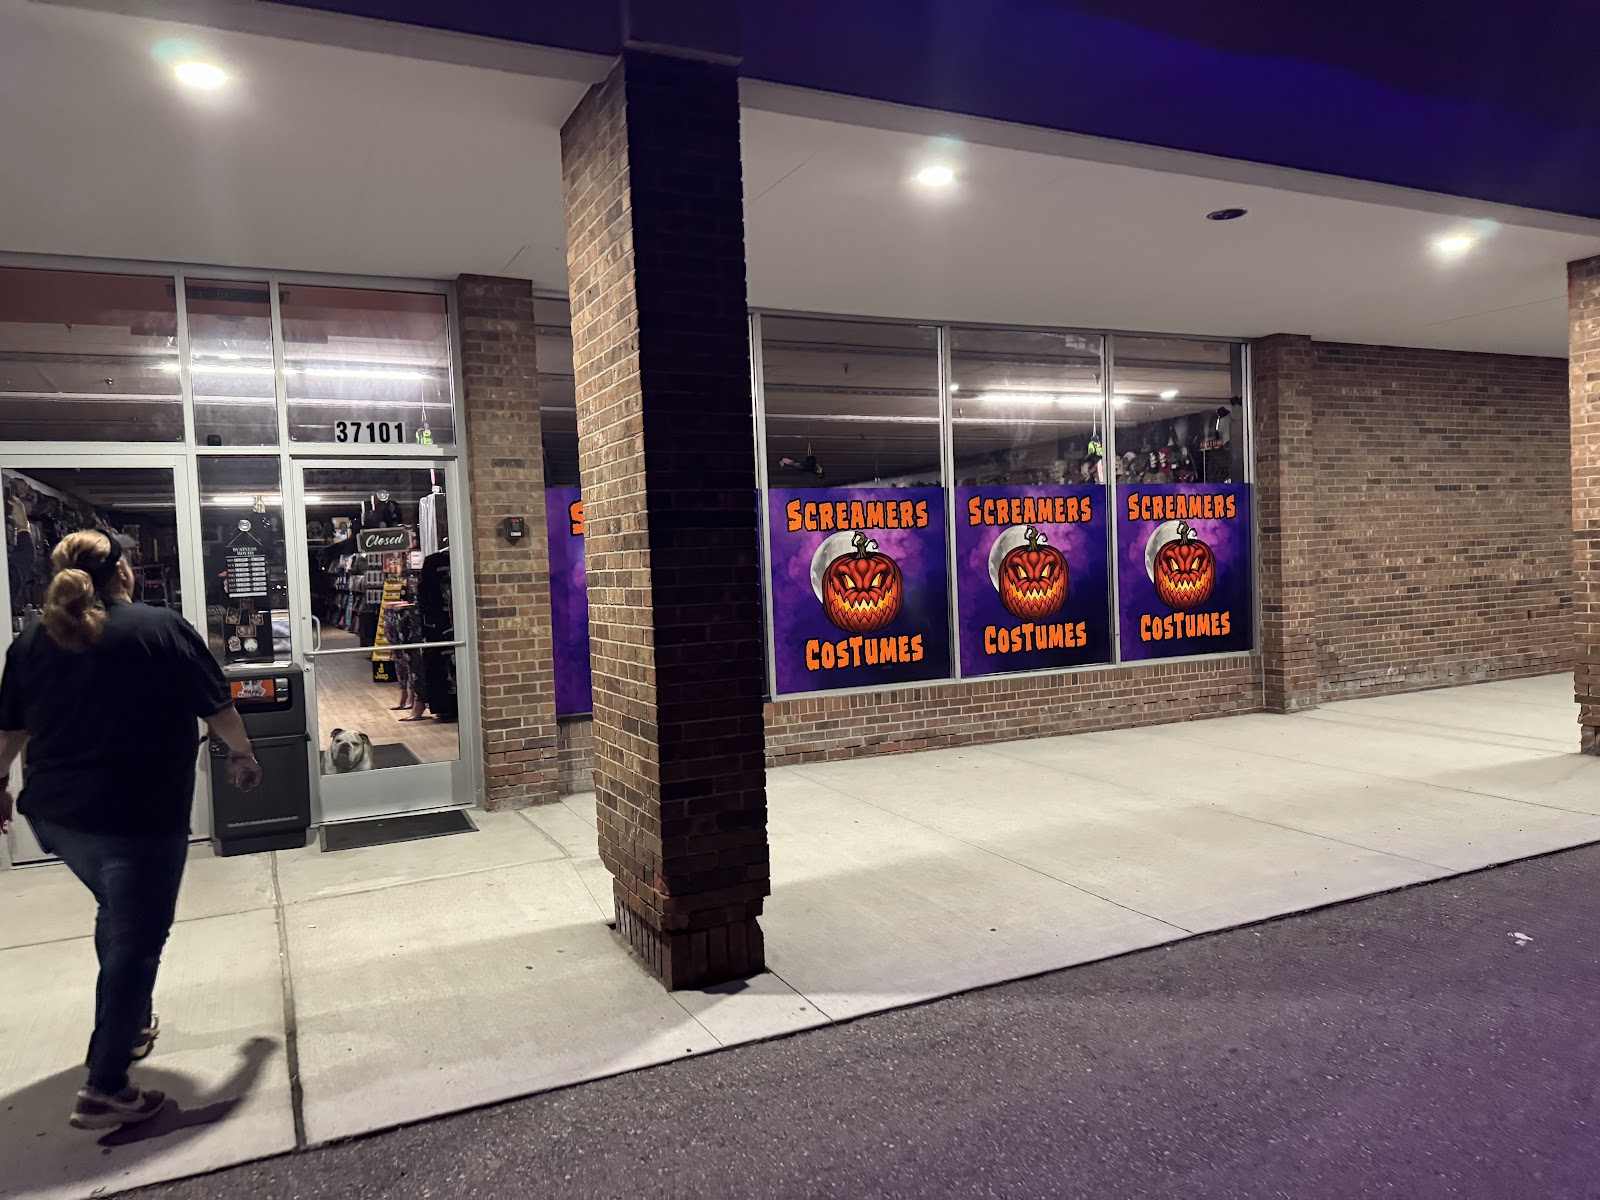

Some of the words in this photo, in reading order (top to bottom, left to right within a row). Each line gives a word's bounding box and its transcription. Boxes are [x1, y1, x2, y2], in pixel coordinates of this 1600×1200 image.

[336, 421, 404, 443] 37101
[786, 499, 929, 532] SCREAMERS
[968, 496, 1092, 526] SCREAMERS
[1128, 493, 1236, 521] SCREAMERS
[365, 533, 404, 548] Closed
[984, 621, 1088, 655] COSTUMES
[1140, 611, 1231, 642] COSTUMES
[805, 634, 924, 671] COSTUMES
[374, 672, 389, 680] Jeep
